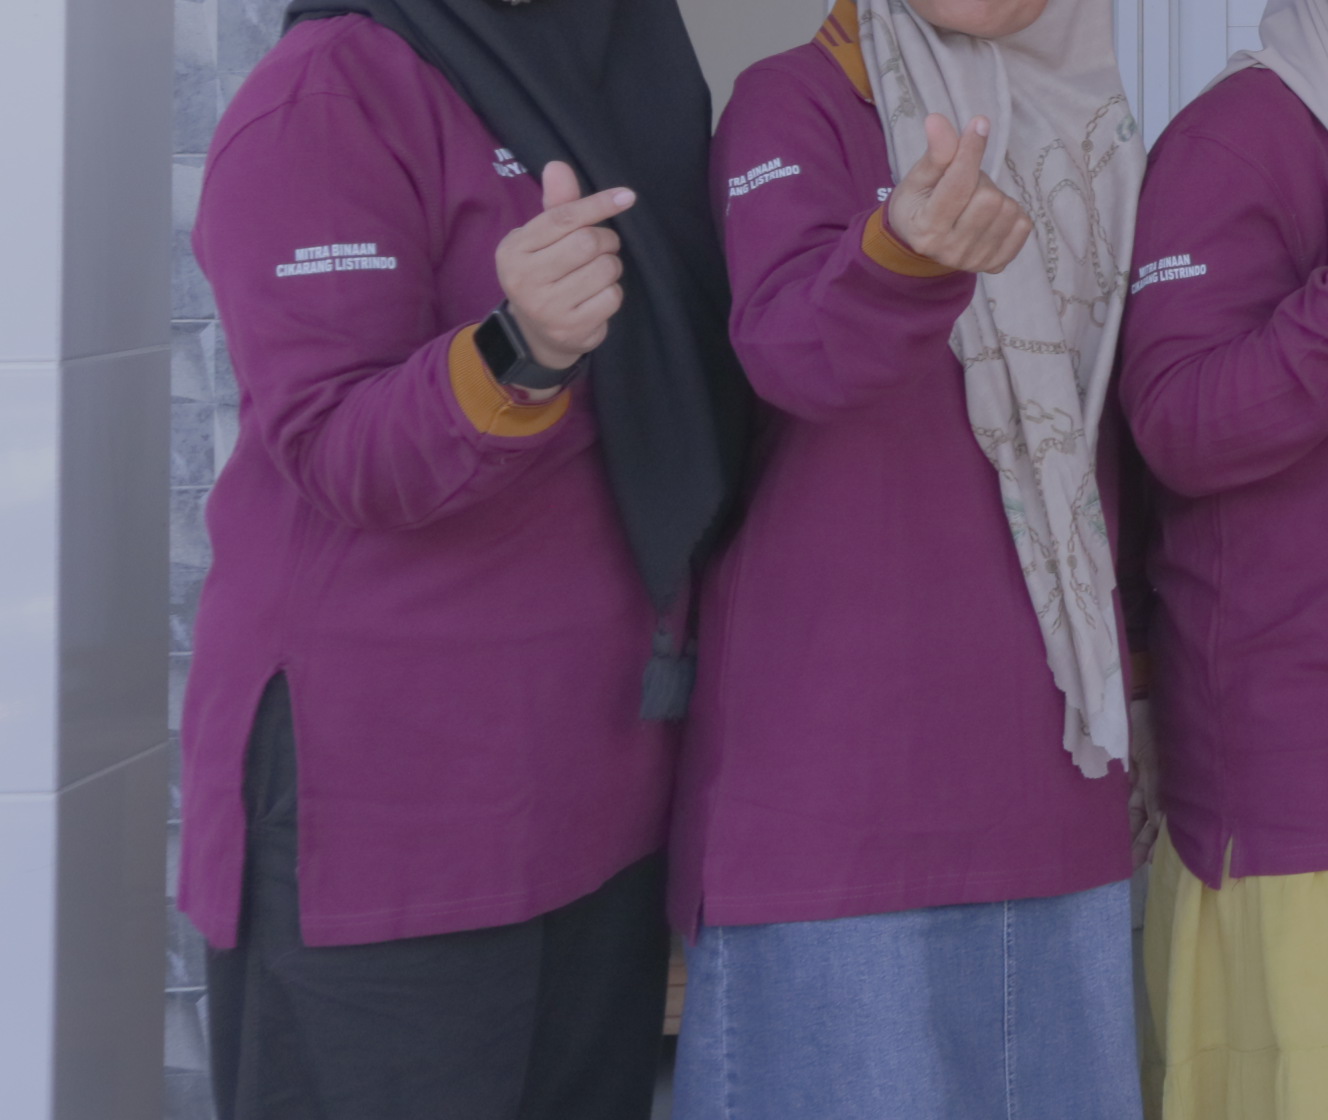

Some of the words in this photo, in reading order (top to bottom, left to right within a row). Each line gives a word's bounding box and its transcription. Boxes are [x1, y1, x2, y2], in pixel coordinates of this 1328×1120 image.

[747, 157, 782, 181] BINAAN
[750, 165, 801, 190] LISTRINDO
[294, 245, 331, 262] MITRA
[331, 243, 377, 256] BINAAN
[1158, 254, 1191, 269] BINAAN
[275, 259, 333, 277] CIKARANG
[334, 256, 397, 271] LISTRINDO
[1160, 264, 1207, 281] LISTRINDO
